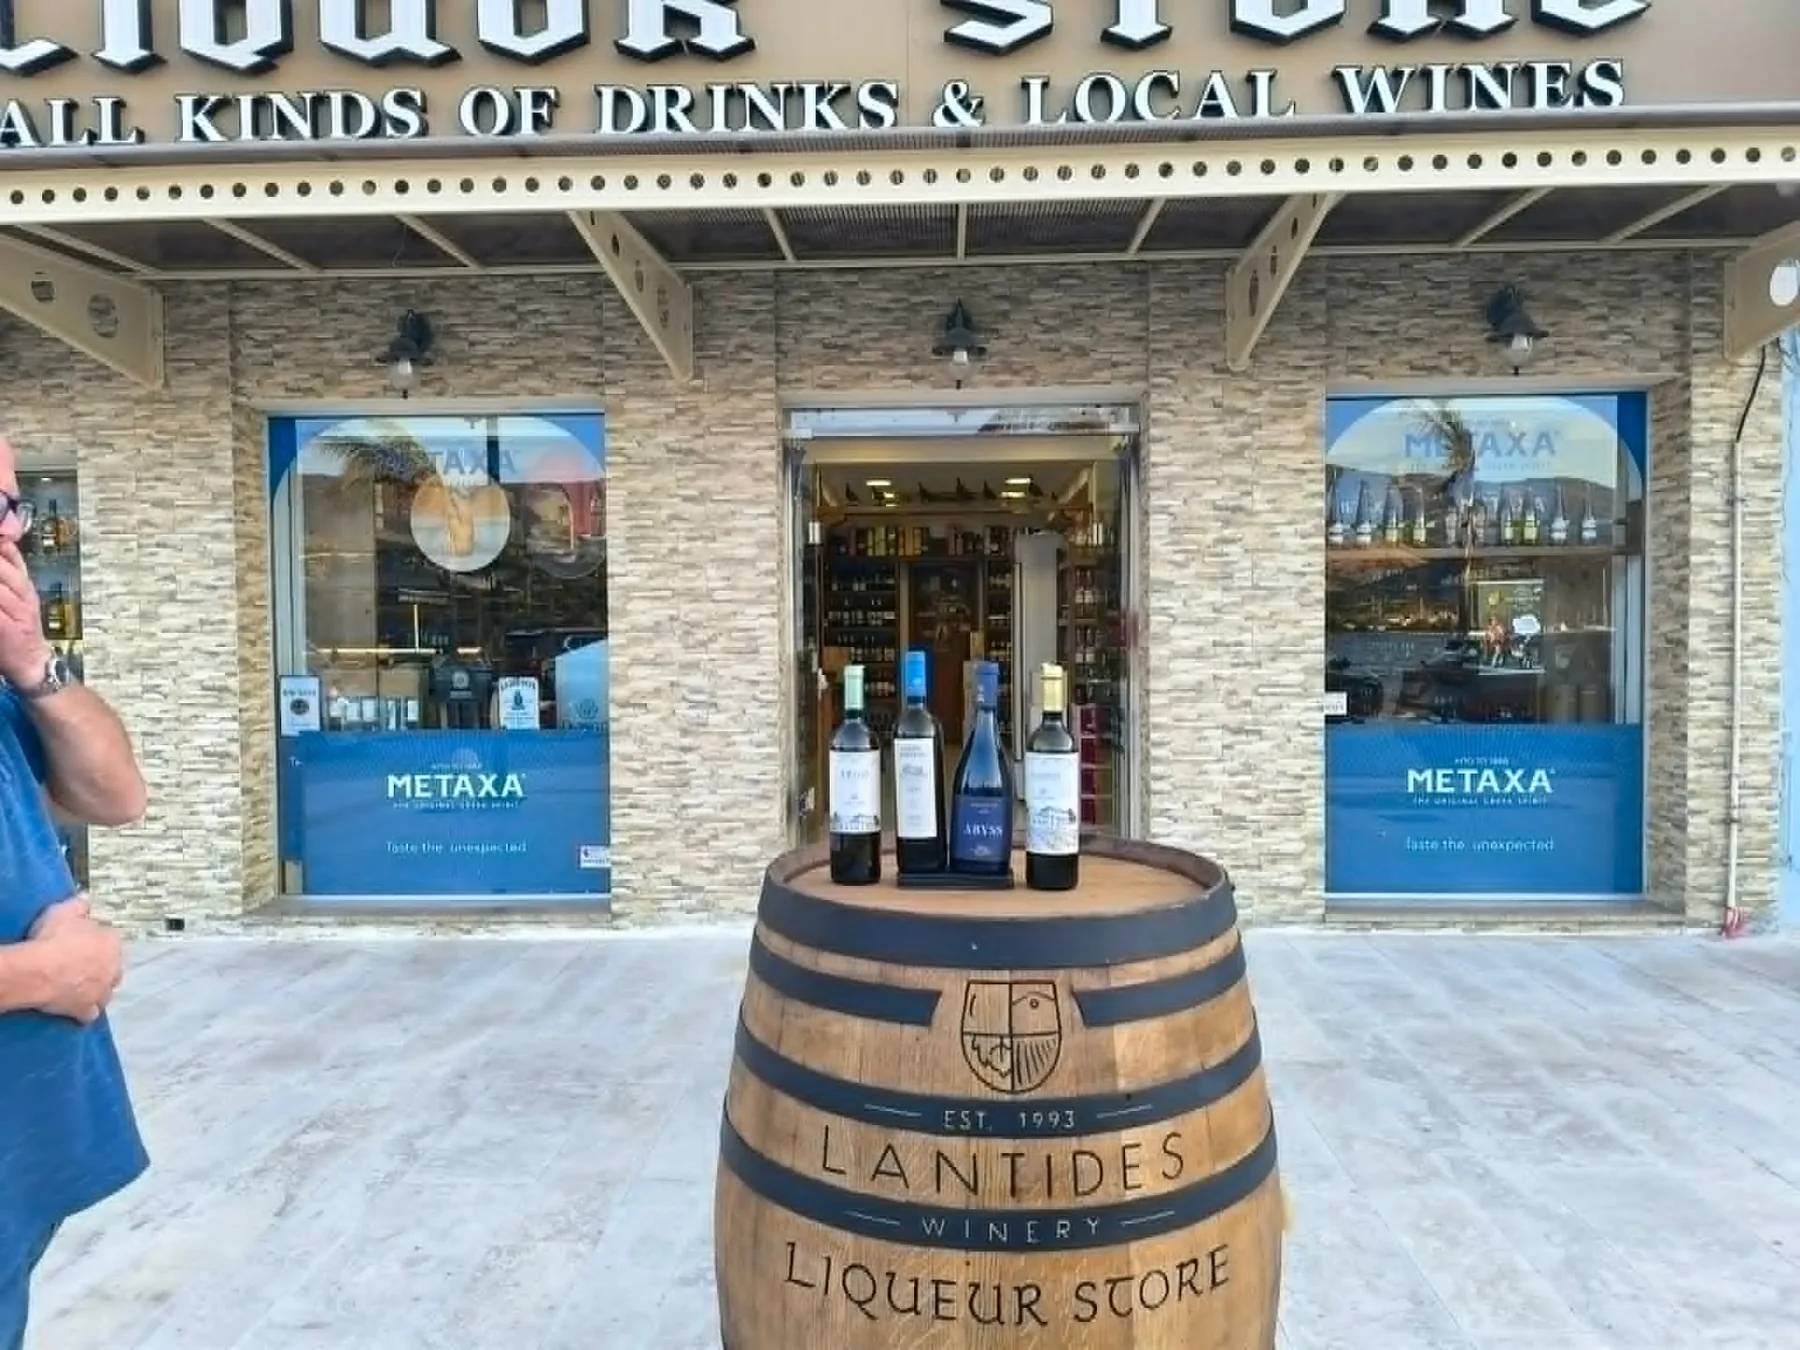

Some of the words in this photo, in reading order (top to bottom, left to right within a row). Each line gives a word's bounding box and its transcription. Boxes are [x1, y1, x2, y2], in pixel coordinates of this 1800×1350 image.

[0, 97, 144, 146] ALL
[175, 88, 429, 142] KINDS
[458, 85, 561, 137] OF
[594, 78, 900, 134] DRINKS
[931, 80, 986, 128] &
[1022, 69, 1296, 126] LOCAL
[1332, 58, 1625, 114] WINES
[387, 773, 524, 798] METAXA
[1407, 768, 1554, 793] METAXA
[1442, 836, 1465, 852] the
[943, 1110, 992, 1130] EST.
[1019, 1110, 1077, 1129] 1993
[821, 1125, 1185, 1197] LANTIDES
[921, 1216, 1102, 1244] WINERY
[783, 1241, 1049, 1326] LIQUEUR
[1073, 1244, 1231, 1323] STORE
